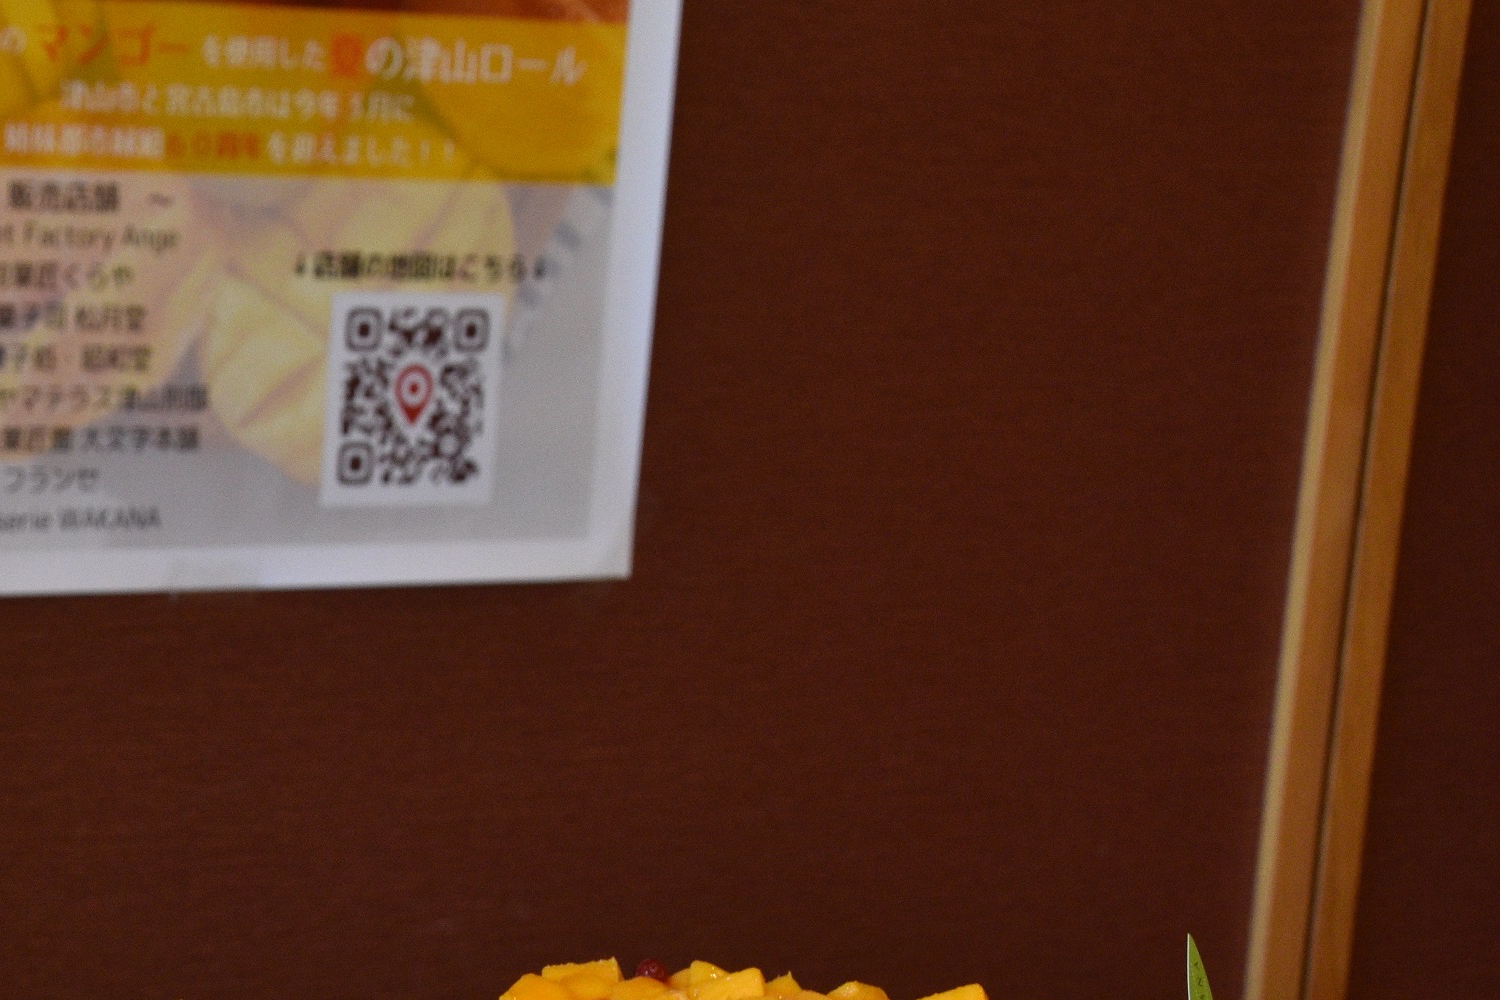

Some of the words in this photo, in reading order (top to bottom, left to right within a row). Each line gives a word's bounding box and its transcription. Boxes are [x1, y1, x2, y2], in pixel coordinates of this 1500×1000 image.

[8, 180, 121, 212] 販売店舗
[23, 222, 115, 252] Factory
[3, 466, 101, 494] フランセ
[57, 507, 161, 532] WAKANA
